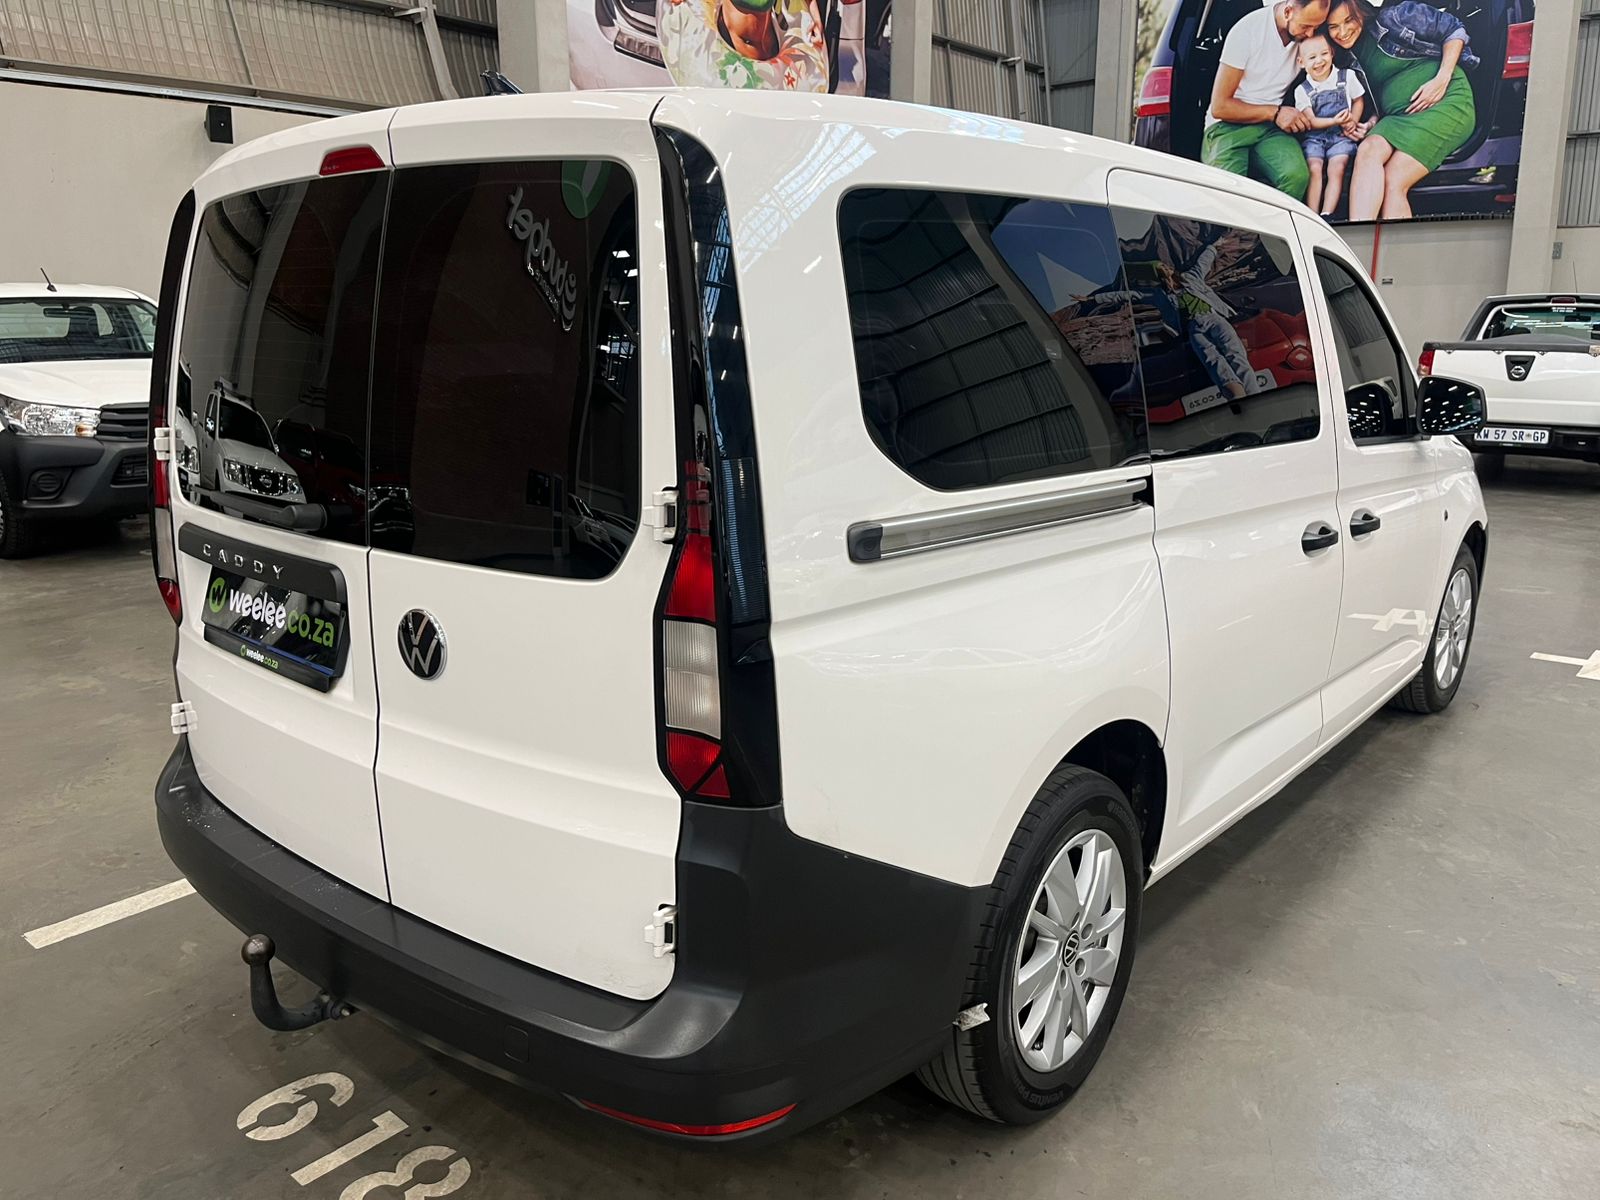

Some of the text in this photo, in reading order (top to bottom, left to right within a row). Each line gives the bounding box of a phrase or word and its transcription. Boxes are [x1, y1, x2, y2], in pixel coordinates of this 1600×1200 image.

[1494, 430, 1507, 440] 57
[1512, 431, 1525, 441] SR
[1533, 432, 1546, 442] GP
[203, 543, 284, 580] CADDY
[237, 1072, 471, 1200] 618
